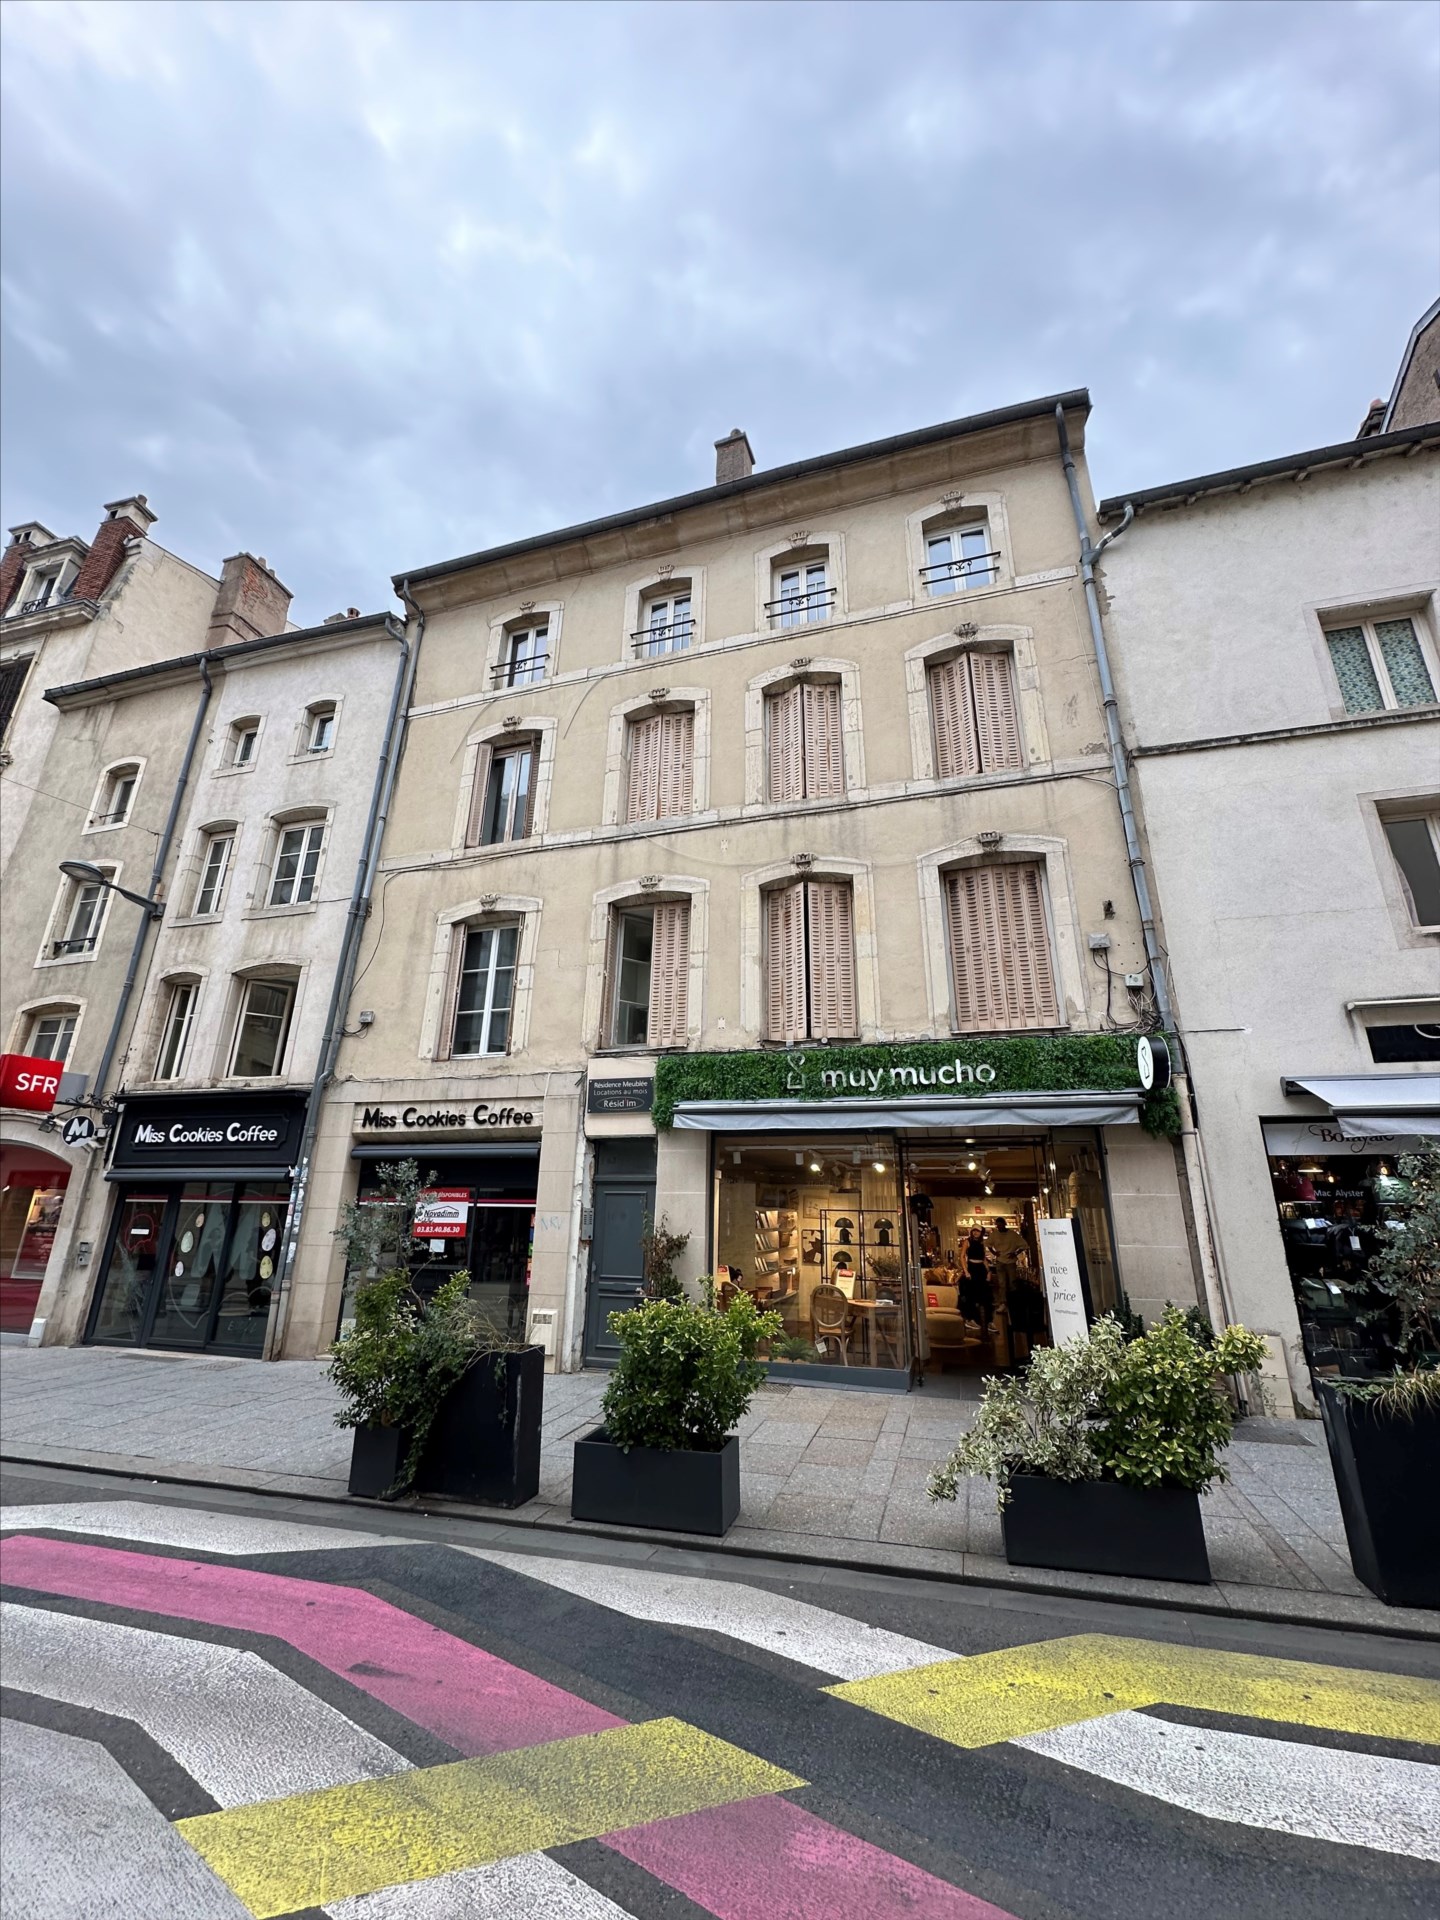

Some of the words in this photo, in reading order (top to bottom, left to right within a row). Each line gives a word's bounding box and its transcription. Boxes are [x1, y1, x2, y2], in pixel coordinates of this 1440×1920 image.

[821, 1067, 884, 1092] muy
[889, 1058, 996, 1086] mucho
[15, 1073, 58, 1095] SFR
[593, 1081, 621, 1089] Résidence
[622, 1080, 648, 1088] Meublée
[362, 1108, 397, 1128] Miss
[402, 1107, 466, 1127] Cookies
[473, 1104, 533, 1125] Coffee
[134, 1124, 166, 1144] Miss
[169, 1123, 224, 1143] Cookies
[226, 1122, 278, 1142] Coffee
[1313, 1189, 1332, 1198] Mac
[1335, 1189, 1365, 1199] Alyster
[423, 1209, 460, 1219] Novadimm
[1050, 1263, 1068, 1275] nice
[1052, 1276, 1060, 1288] &
[1053, 1289, 1076, 1303] price
